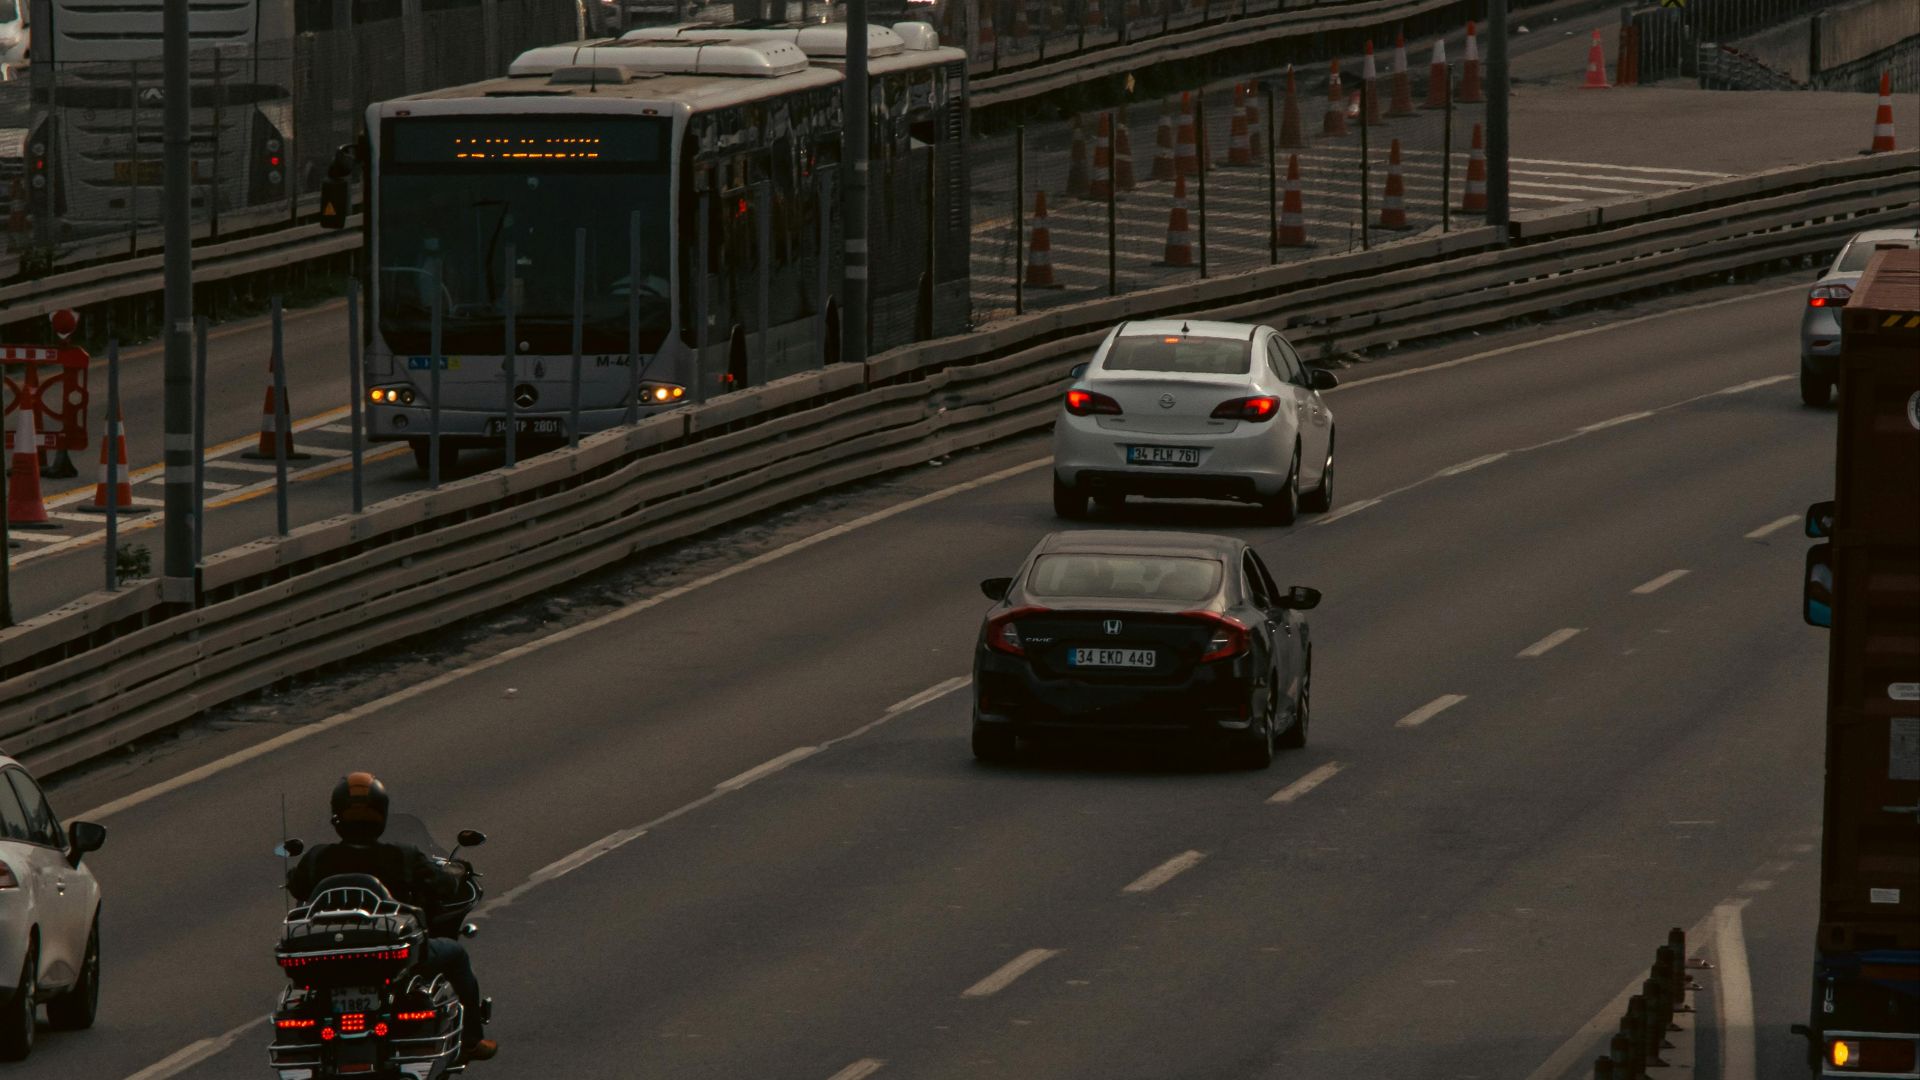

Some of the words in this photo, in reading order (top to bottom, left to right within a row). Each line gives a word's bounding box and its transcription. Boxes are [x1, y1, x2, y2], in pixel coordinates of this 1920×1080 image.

[1136, 448, 1148, 459] 34
[1179, 449, 1197, 462] 761
[1077, 650, 1093, 664] 34
[1129, 652, 1153, 667] 449
